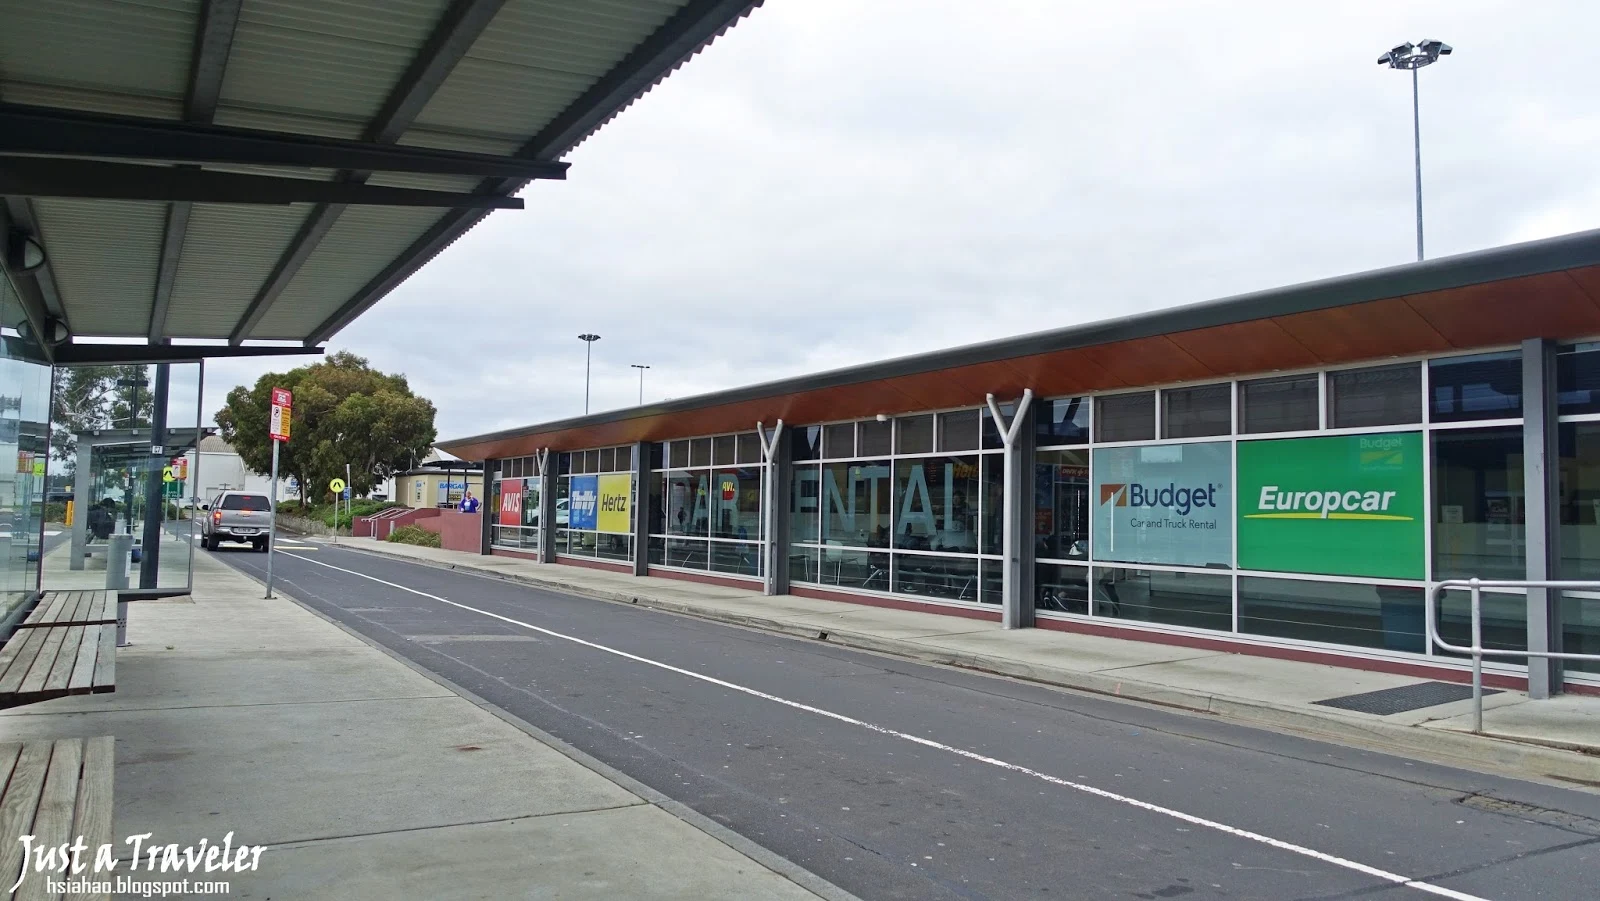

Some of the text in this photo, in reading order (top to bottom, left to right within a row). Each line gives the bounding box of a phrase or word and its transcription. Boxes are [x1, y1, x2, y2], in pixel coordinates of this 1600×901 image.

[1360, 437, 1403, 450] Budget
[502, 492, 520, 513] AVIS
[601, 493, 627, 512] Hertz
[1130, 482, 1216, 516] Budget
[1258, 485, 1396, 519] Europcar
[1130, 518, 1217, 530] Car and Truck Rental
